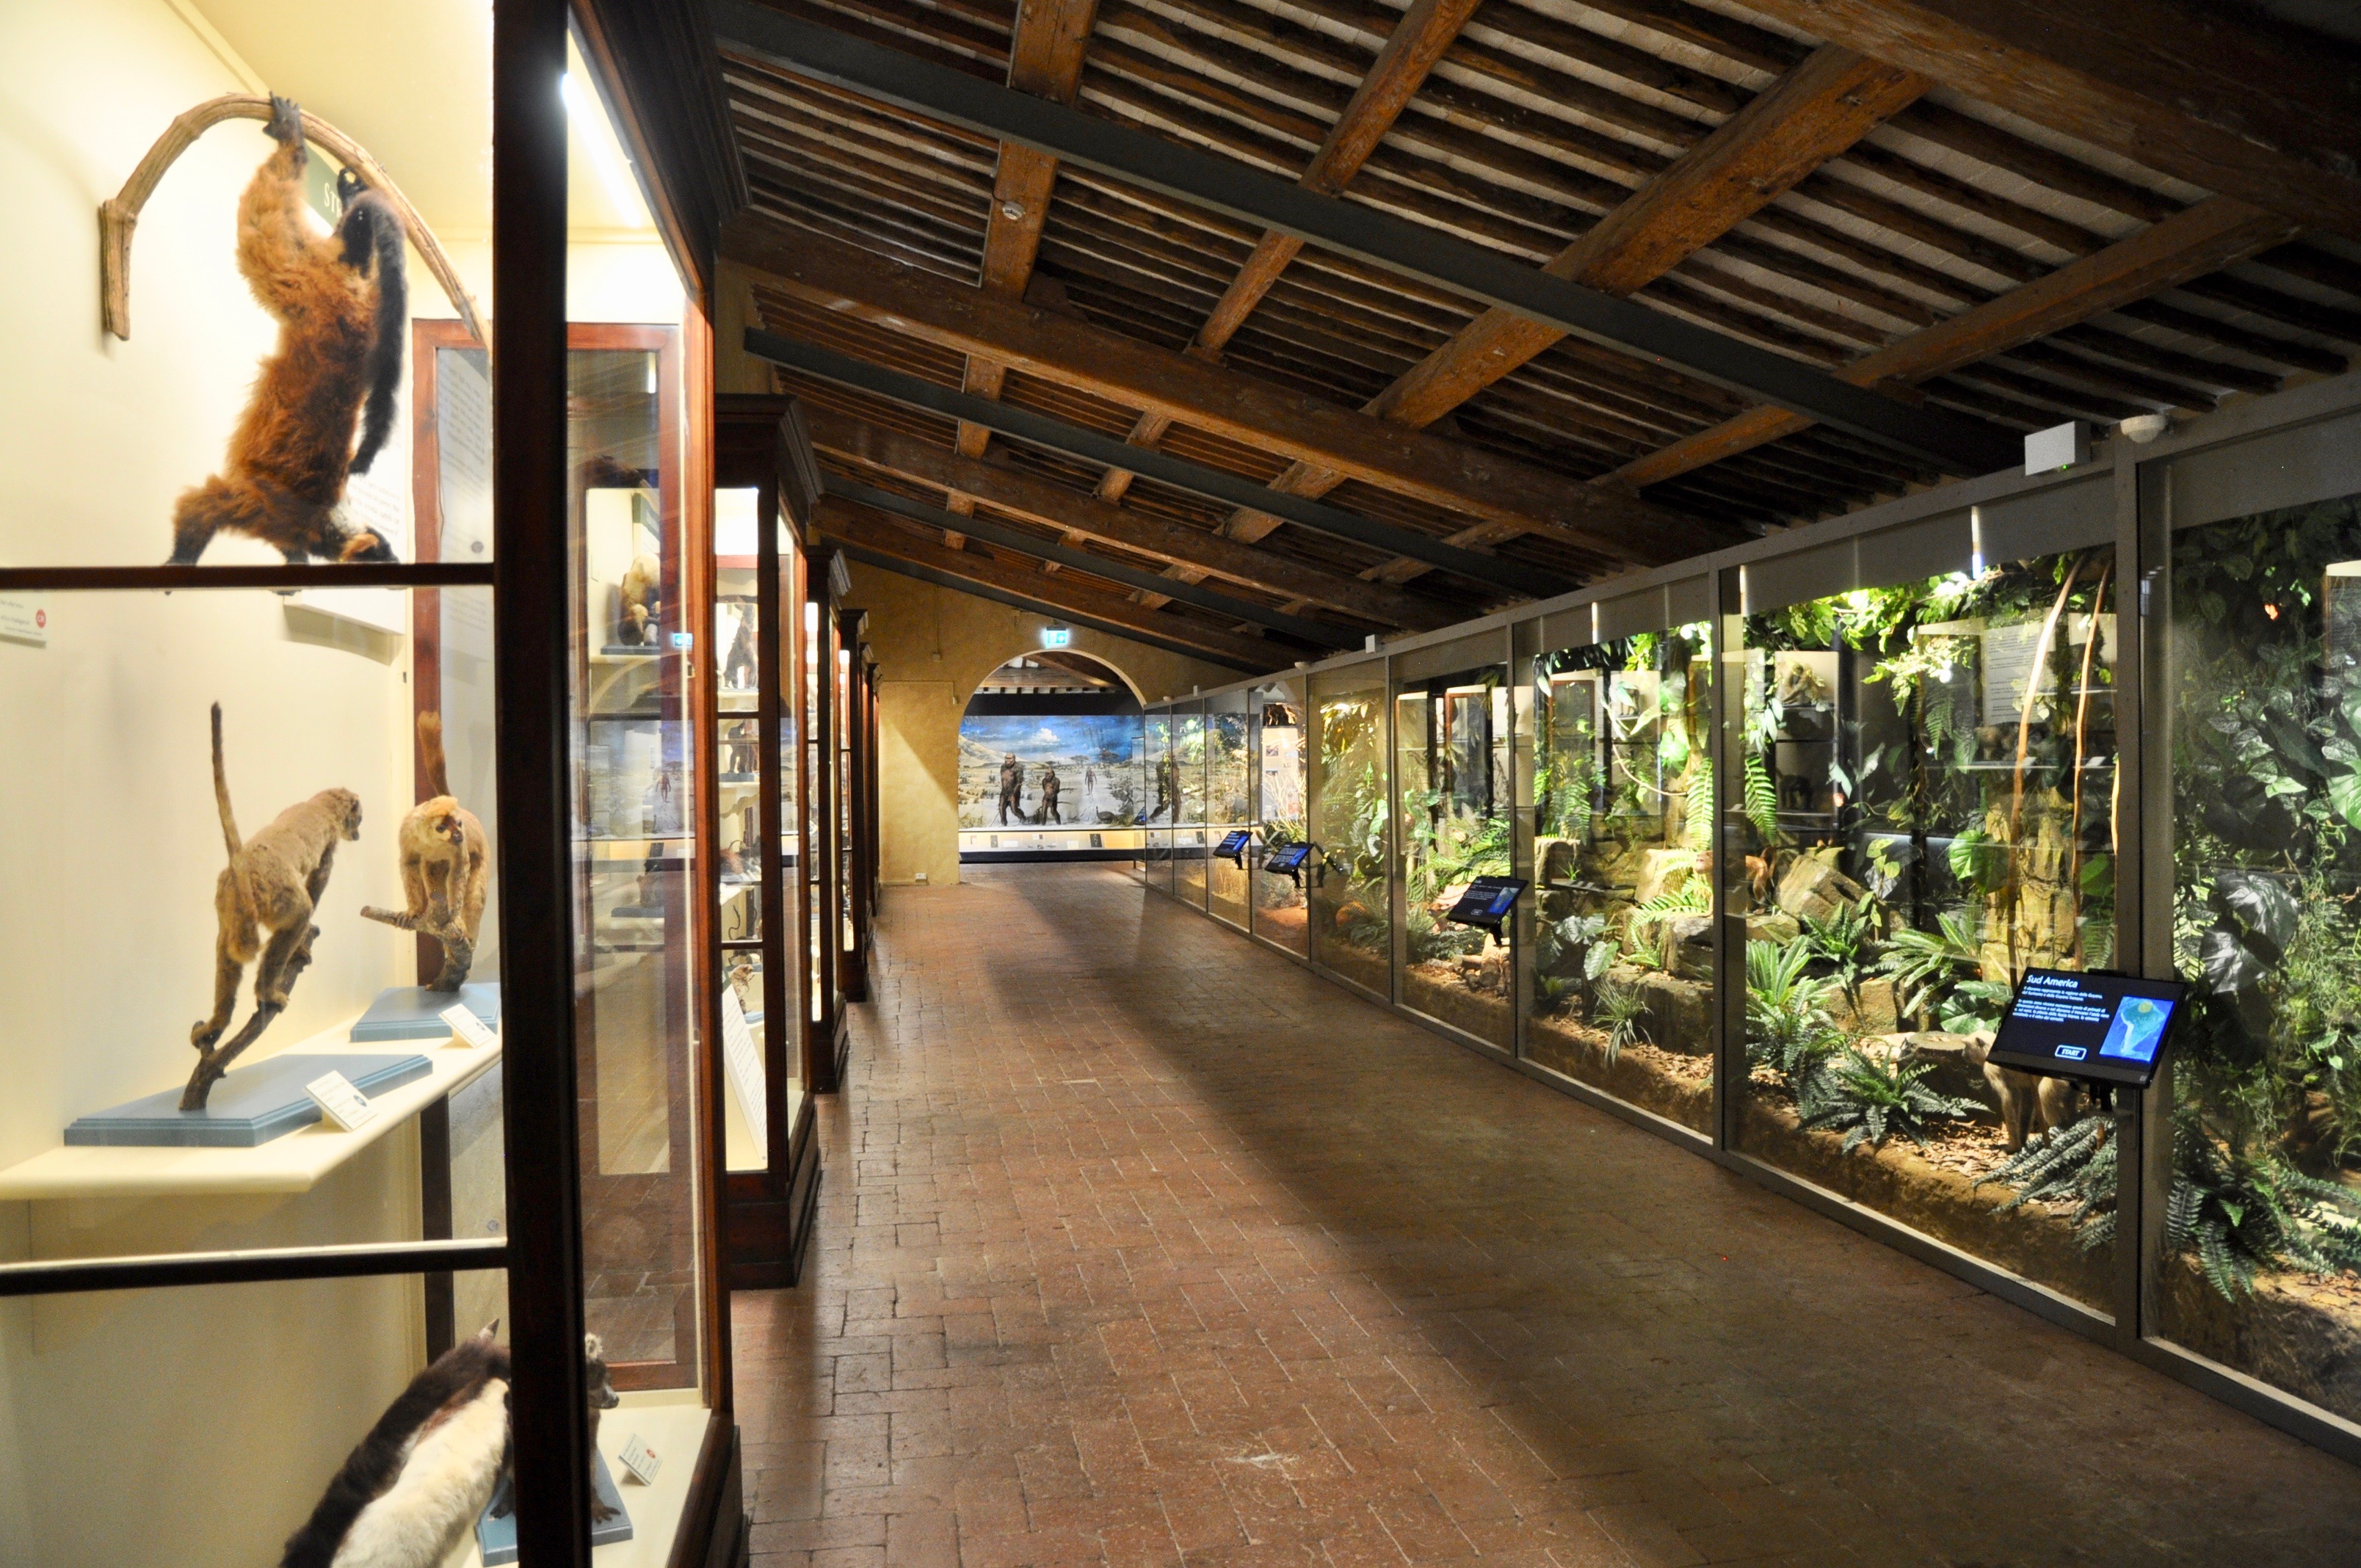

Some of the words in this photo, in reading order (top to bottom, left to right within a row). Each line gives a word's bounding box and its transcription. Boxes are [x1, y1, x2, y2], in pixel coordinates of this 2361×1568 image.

[2026, 975, 2043, 984] Sud
[2043, 976, 2078, 987] America
[2061, 1048, 2080, 1056] START
